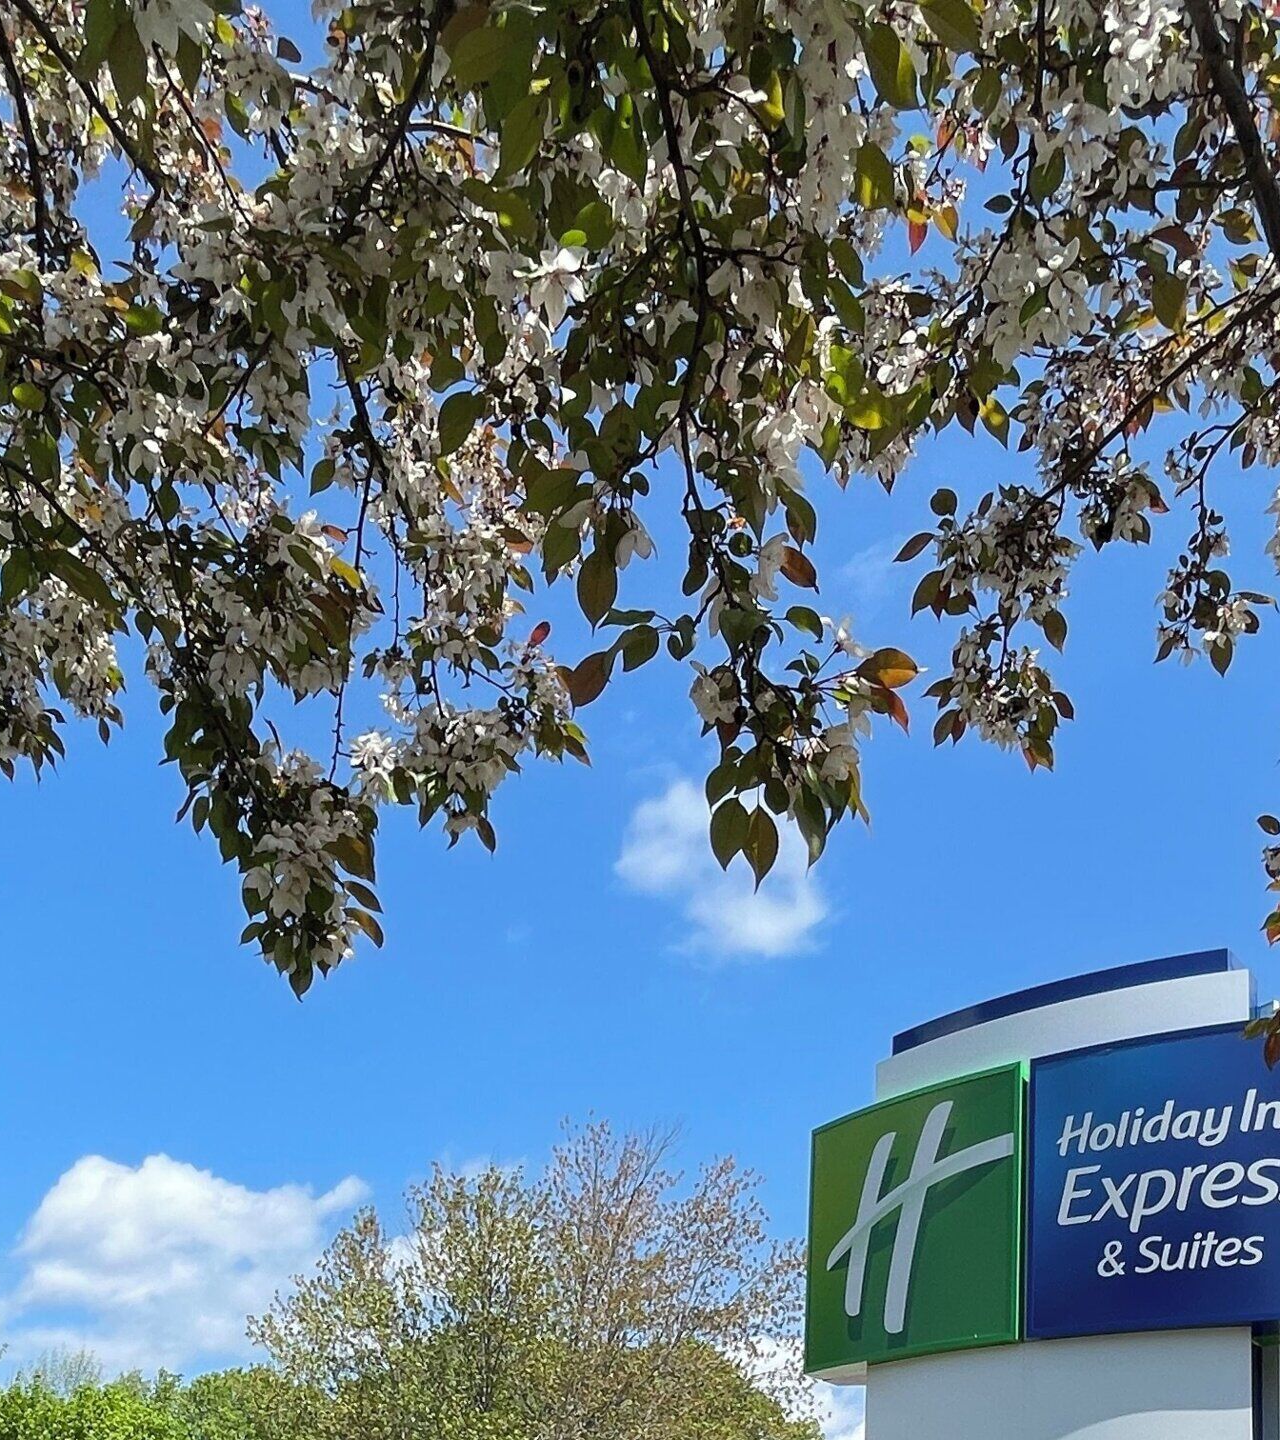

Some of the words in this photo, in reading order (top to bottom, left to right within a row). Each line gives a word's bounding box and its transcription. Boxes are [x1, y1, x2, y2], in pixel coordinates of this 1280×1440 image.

[1056, 1099, 1233, 1157] Holiday
[1096, 1240, 1126, 1278] &
[1133, 1230, 1266, 1275] Suites
